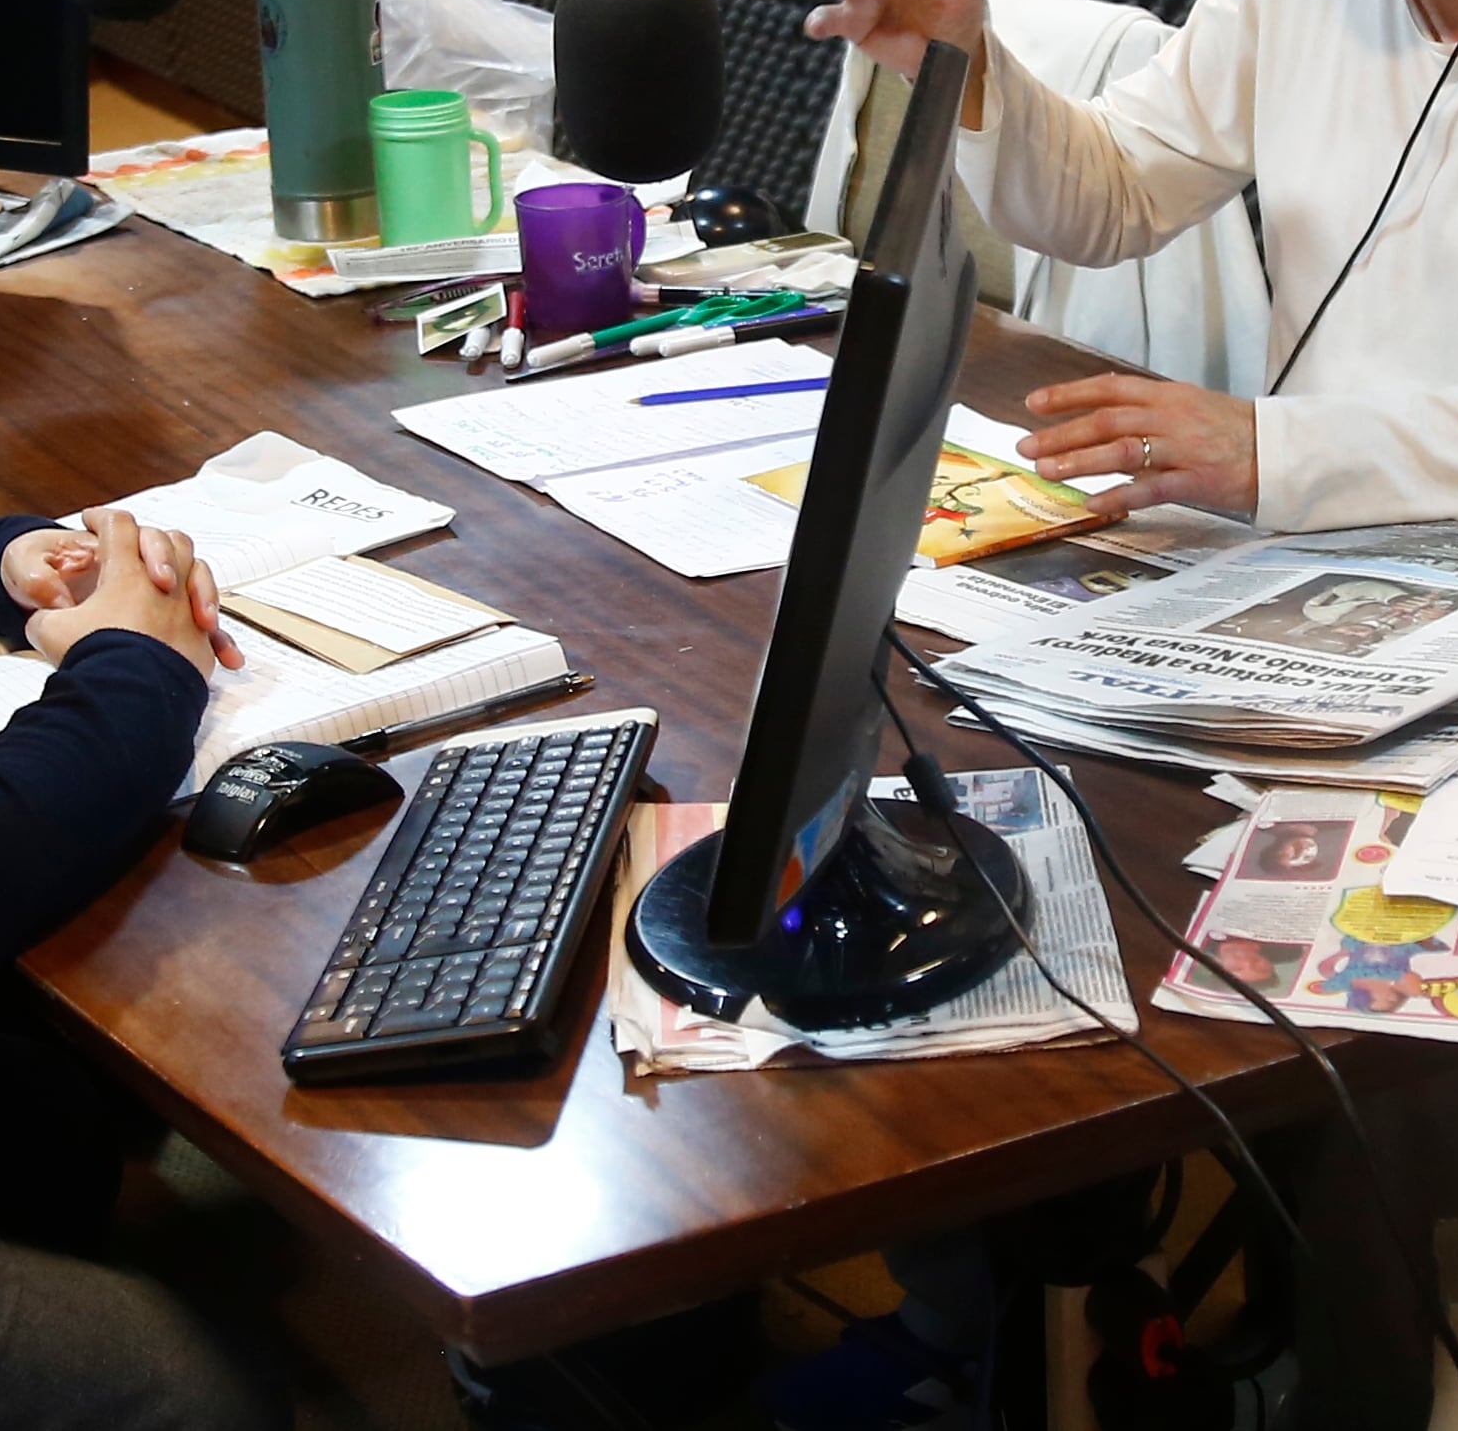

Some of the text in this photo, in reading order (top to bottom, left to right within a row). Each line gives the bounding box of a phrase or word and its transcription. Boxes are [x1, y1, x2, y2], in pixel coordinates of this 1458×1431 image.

[299, 487, 395, 520] REDES
[1071, 630, 1144, 649] York
[1147, 638, 1243, 664] Nueva
[1050, 640, 1171, 669] Maduro
[1190, 662, 1317, 689] capturó
